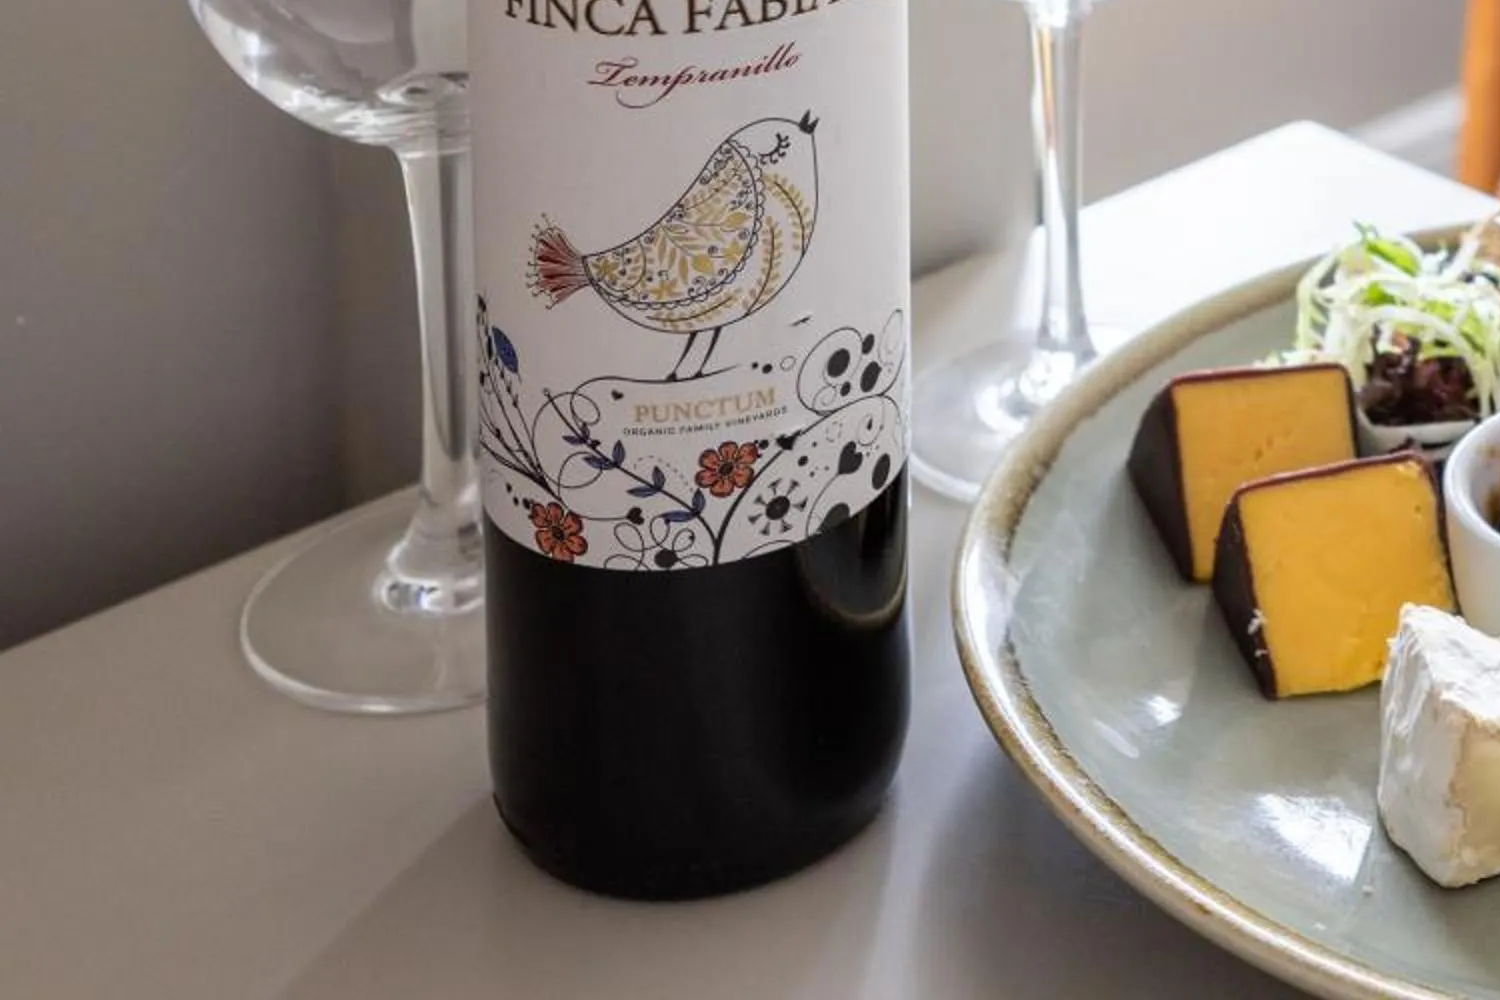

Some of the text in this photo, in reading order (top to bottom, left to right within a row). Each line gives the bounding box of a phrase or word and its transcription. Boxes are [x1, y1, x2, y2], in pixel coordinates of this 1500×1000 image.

[587, 40, 803, 109] Tempranillo
[622, 405, 789, 438] ORGANIC FAMILY VINEYARDS
[633, 388, 776, 423] PUNCTUM
